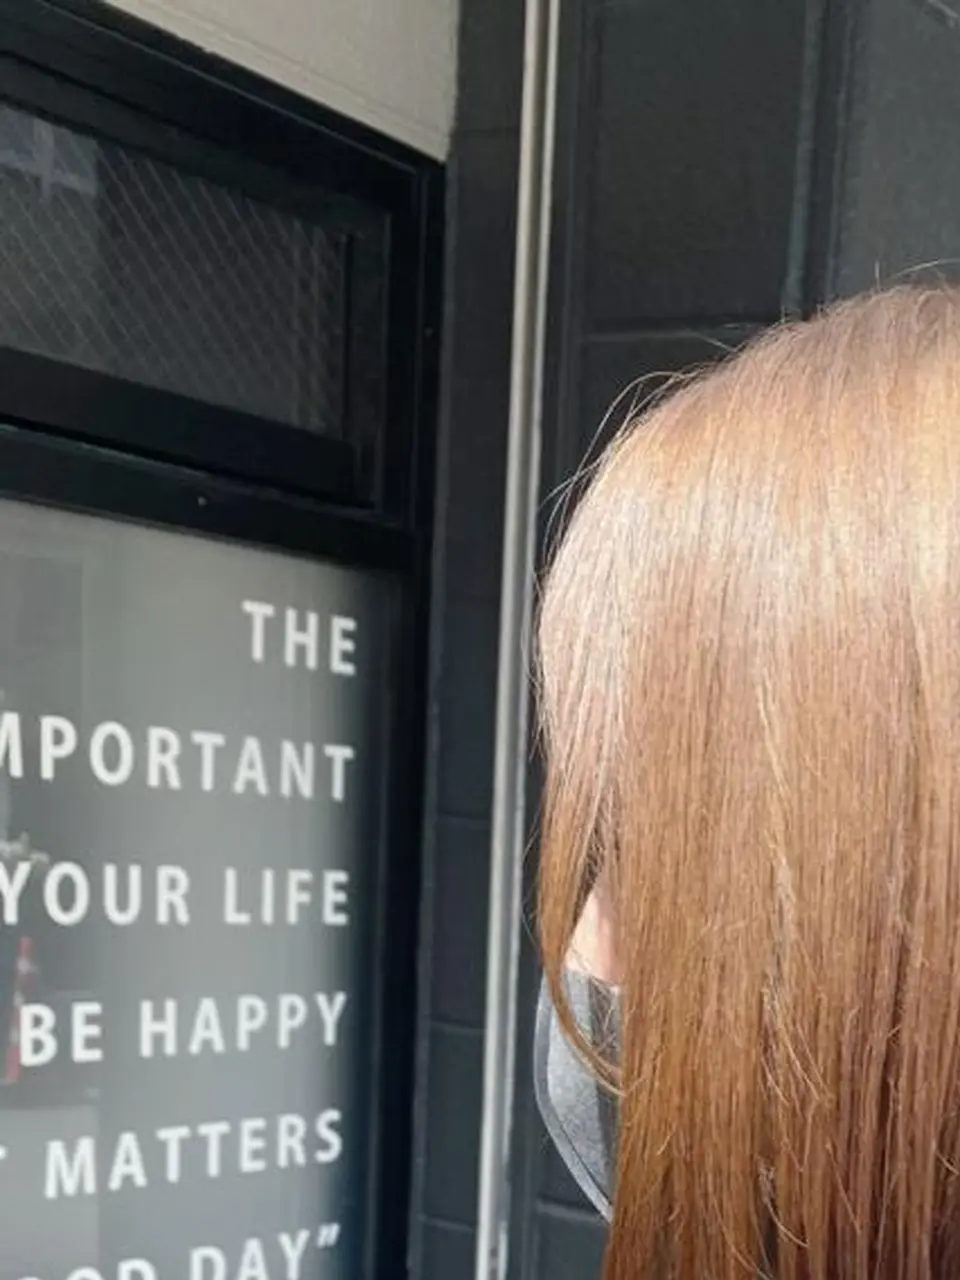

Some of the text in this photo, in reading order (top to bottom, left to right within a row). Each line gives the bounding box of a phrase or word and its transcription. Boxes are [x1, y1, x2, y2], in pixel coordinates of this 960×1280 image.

[242, 599, 357, 676] THE
[0, 860, 349, 926] YOUR LIFE
[19, 991, 346, 1066] BE HAPPY
[43, 1108, 343, 1200] MATTERS
